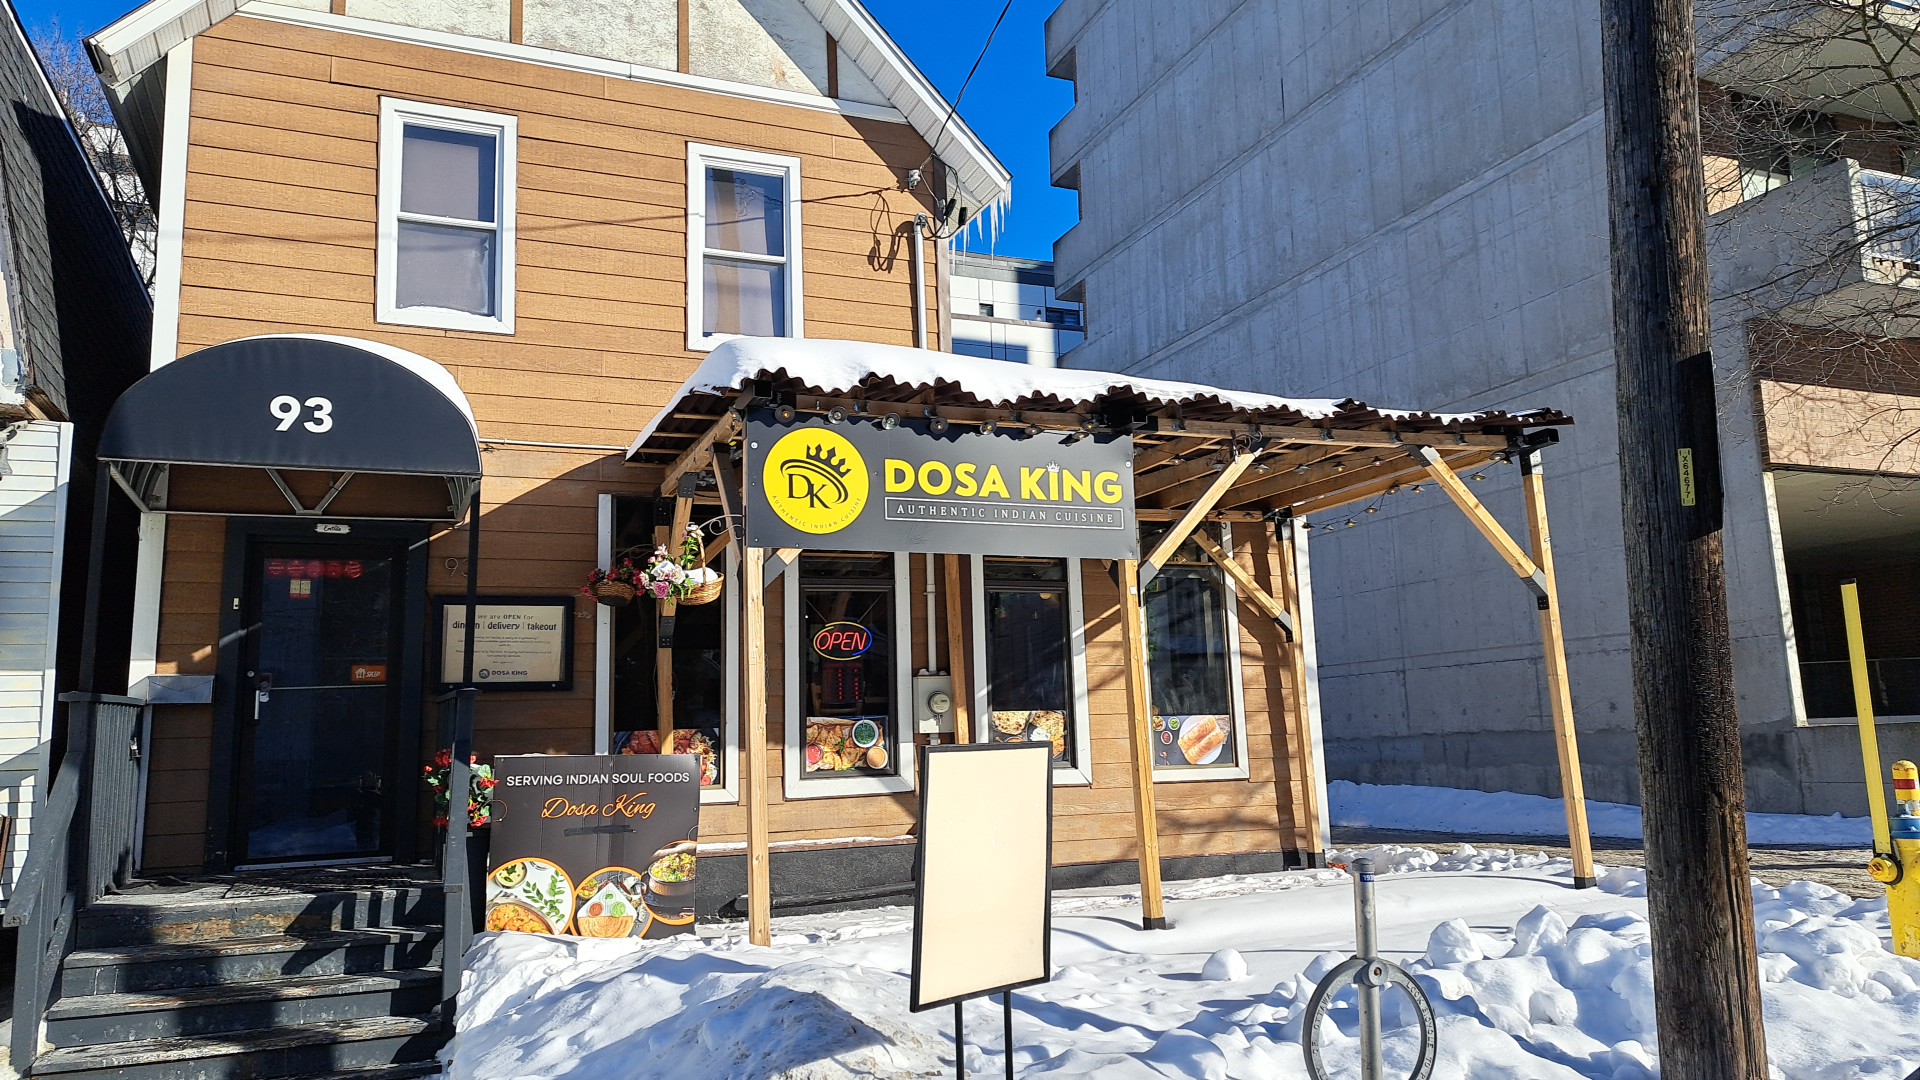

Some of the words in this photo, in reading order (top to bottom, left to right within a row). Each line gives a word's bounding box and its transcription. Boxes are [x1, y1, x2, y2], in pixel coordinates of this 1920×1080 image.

[269, 395, 333, 433] 93
[787, 473, 832, 509] DK
[885, 459, 1010, 499] DOSA
[1020, 463, 1123, 504] KING
[1682, 456, 1690, 498] X64677
[772, 495, 806, 527] AUTHENTIC
[810, 521, 838, 529] INDIAN
[840, 498, 861, 522] CUISINE
[897, 504, 986, 519] AUTHENTIC
[994, 508, 1046, 520] INDIAN
[1055, 511, 1114, 524] CUISINE
[487, 621, 520, 630] delivery
[527, 622, 557, 631] takeout
[816, 631, 867, 651] OPEN
[506, 774, 563, 787] SERVING
[566, 773, 609, 786] INDIAN
[611, 773, 645, 785] SOUL
[647, 772, 690, 784] FOODS
[541, 797, 598, 819] Dosa
[602, 792, 656, 820] King
